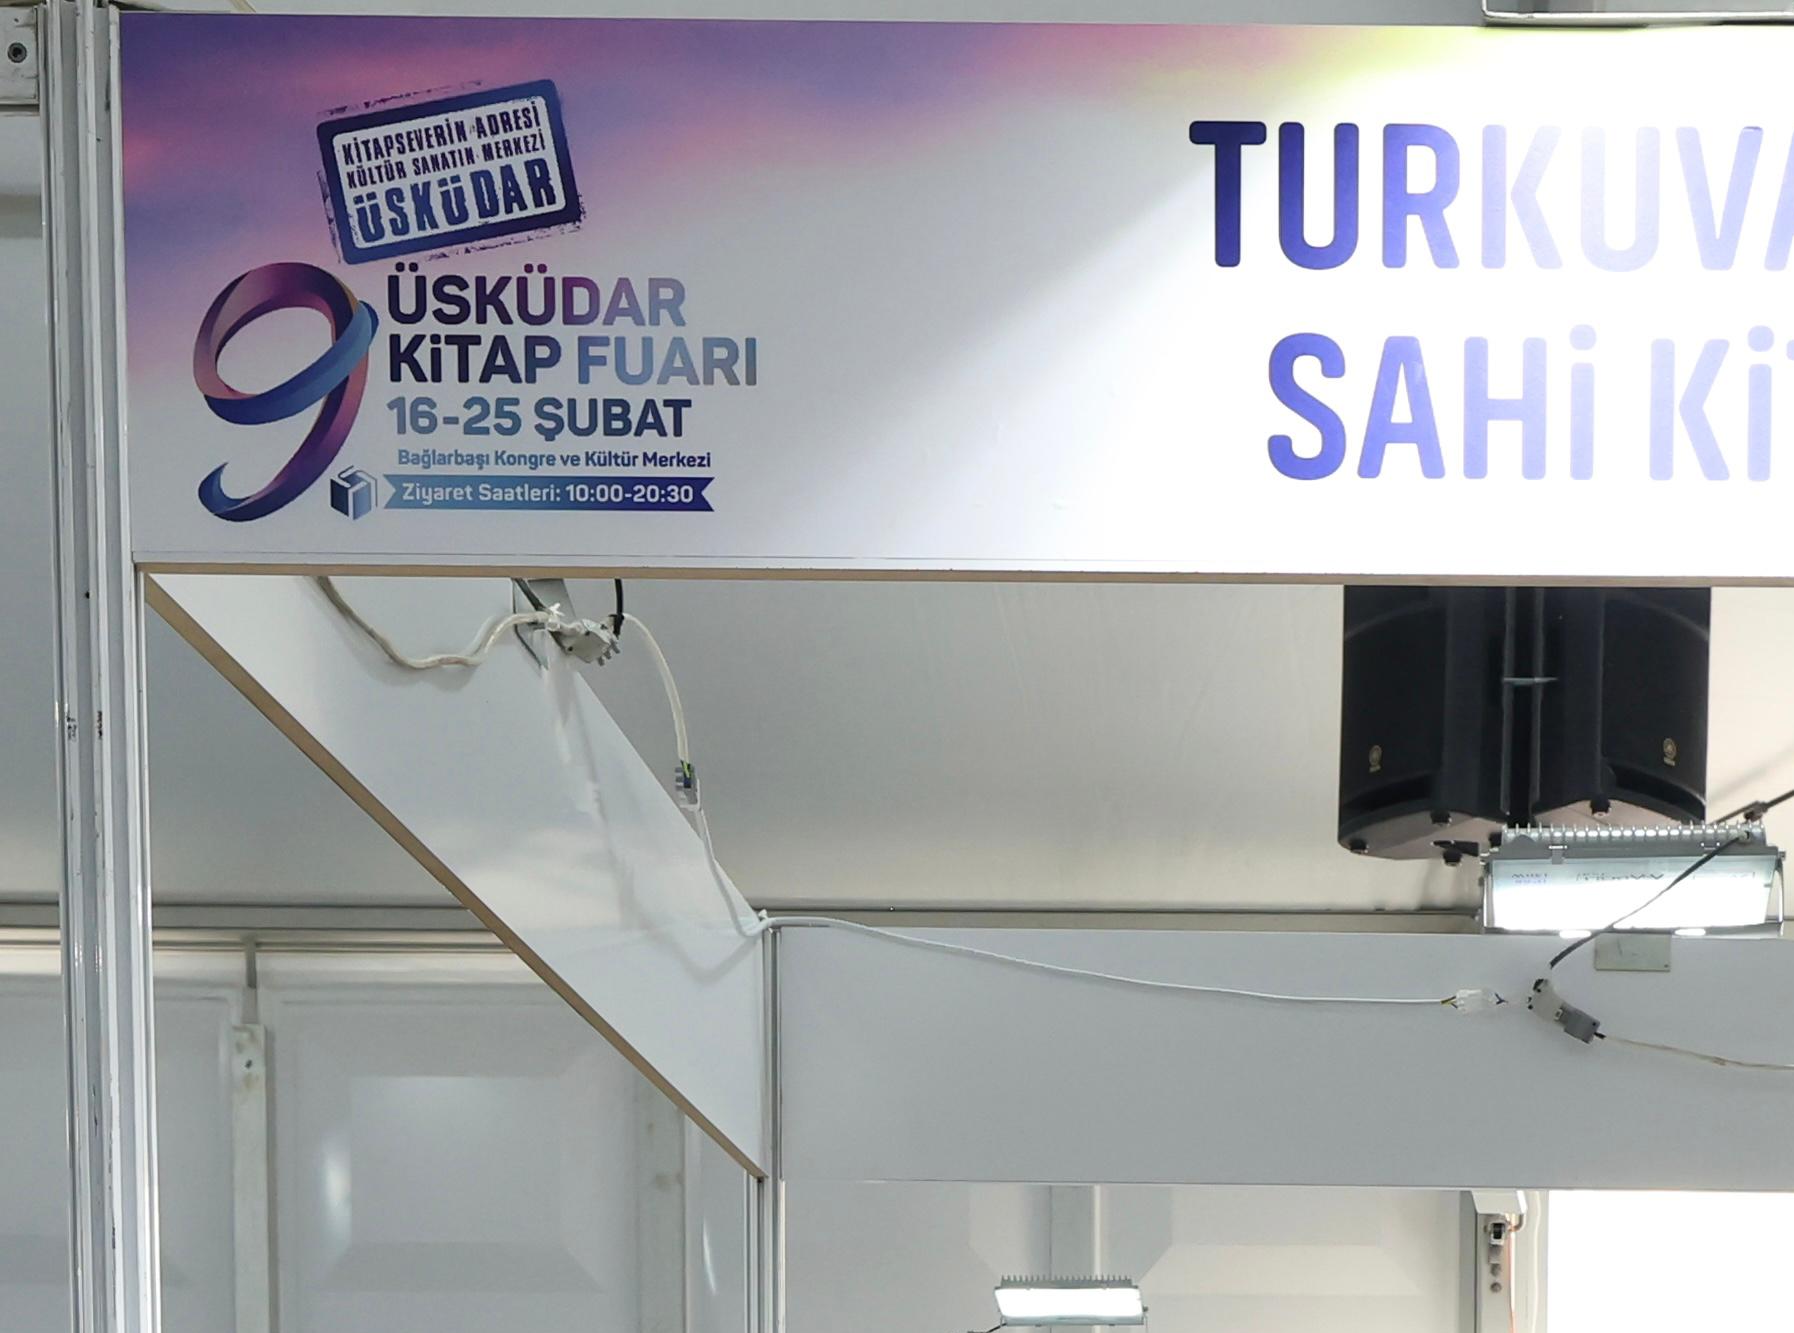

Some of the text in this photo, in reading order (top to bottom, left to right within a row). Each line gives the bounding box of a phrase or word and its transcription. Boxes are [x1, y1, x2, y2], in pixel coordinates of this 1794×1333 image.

[476, 100, 541, 139] ADRESİ
[346, 131, 546, 190] KÜLTÜR SANATIN MERKEZİ
[353, 157, 558, 243] ÜSKÜDAR
[387, 263, 687, 327] ÜSKÜDAR
[577, 336, 758, 387] FUARI
[387, 396, 692, 442] 16-25 ŞUBAT
[397, 449, 712, 471] Bağlarbaşı Kongre ve Kültür Merkezi
[401, 481, 694, 504] Ziyaret Saatleri: 10:00-20:30
